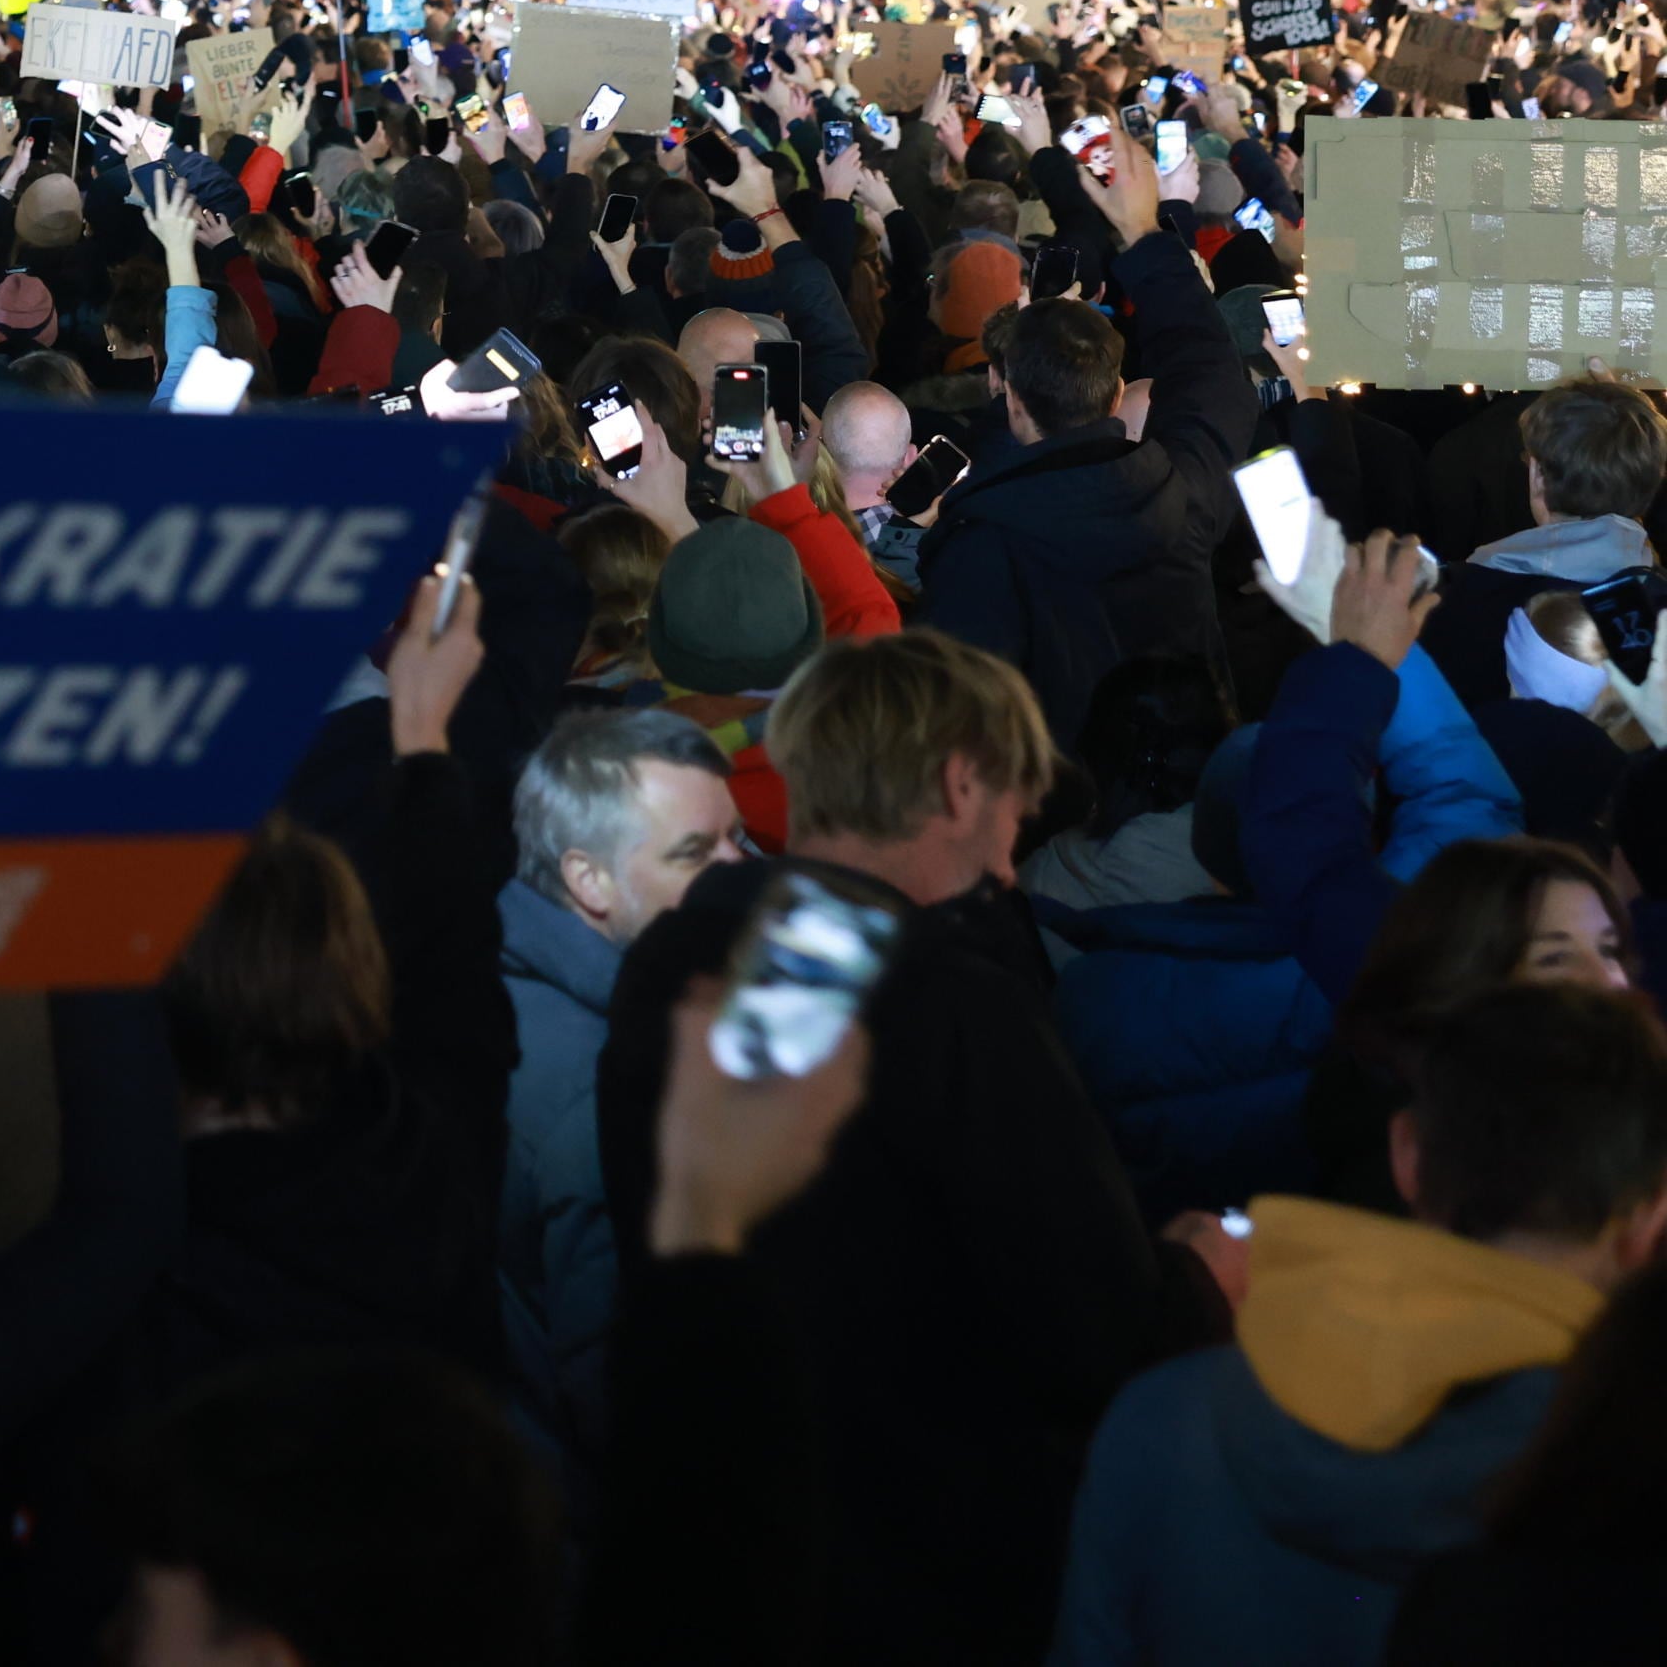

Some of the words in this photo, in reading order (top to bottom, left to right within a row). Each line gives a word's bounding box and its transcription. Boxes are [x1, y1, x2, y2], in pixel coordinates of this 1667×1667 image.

[205, 40, 257, 62] LIEBER
[212, 58, 256, 78] BUNTE
[381, 397, 412, 415] 17:41
